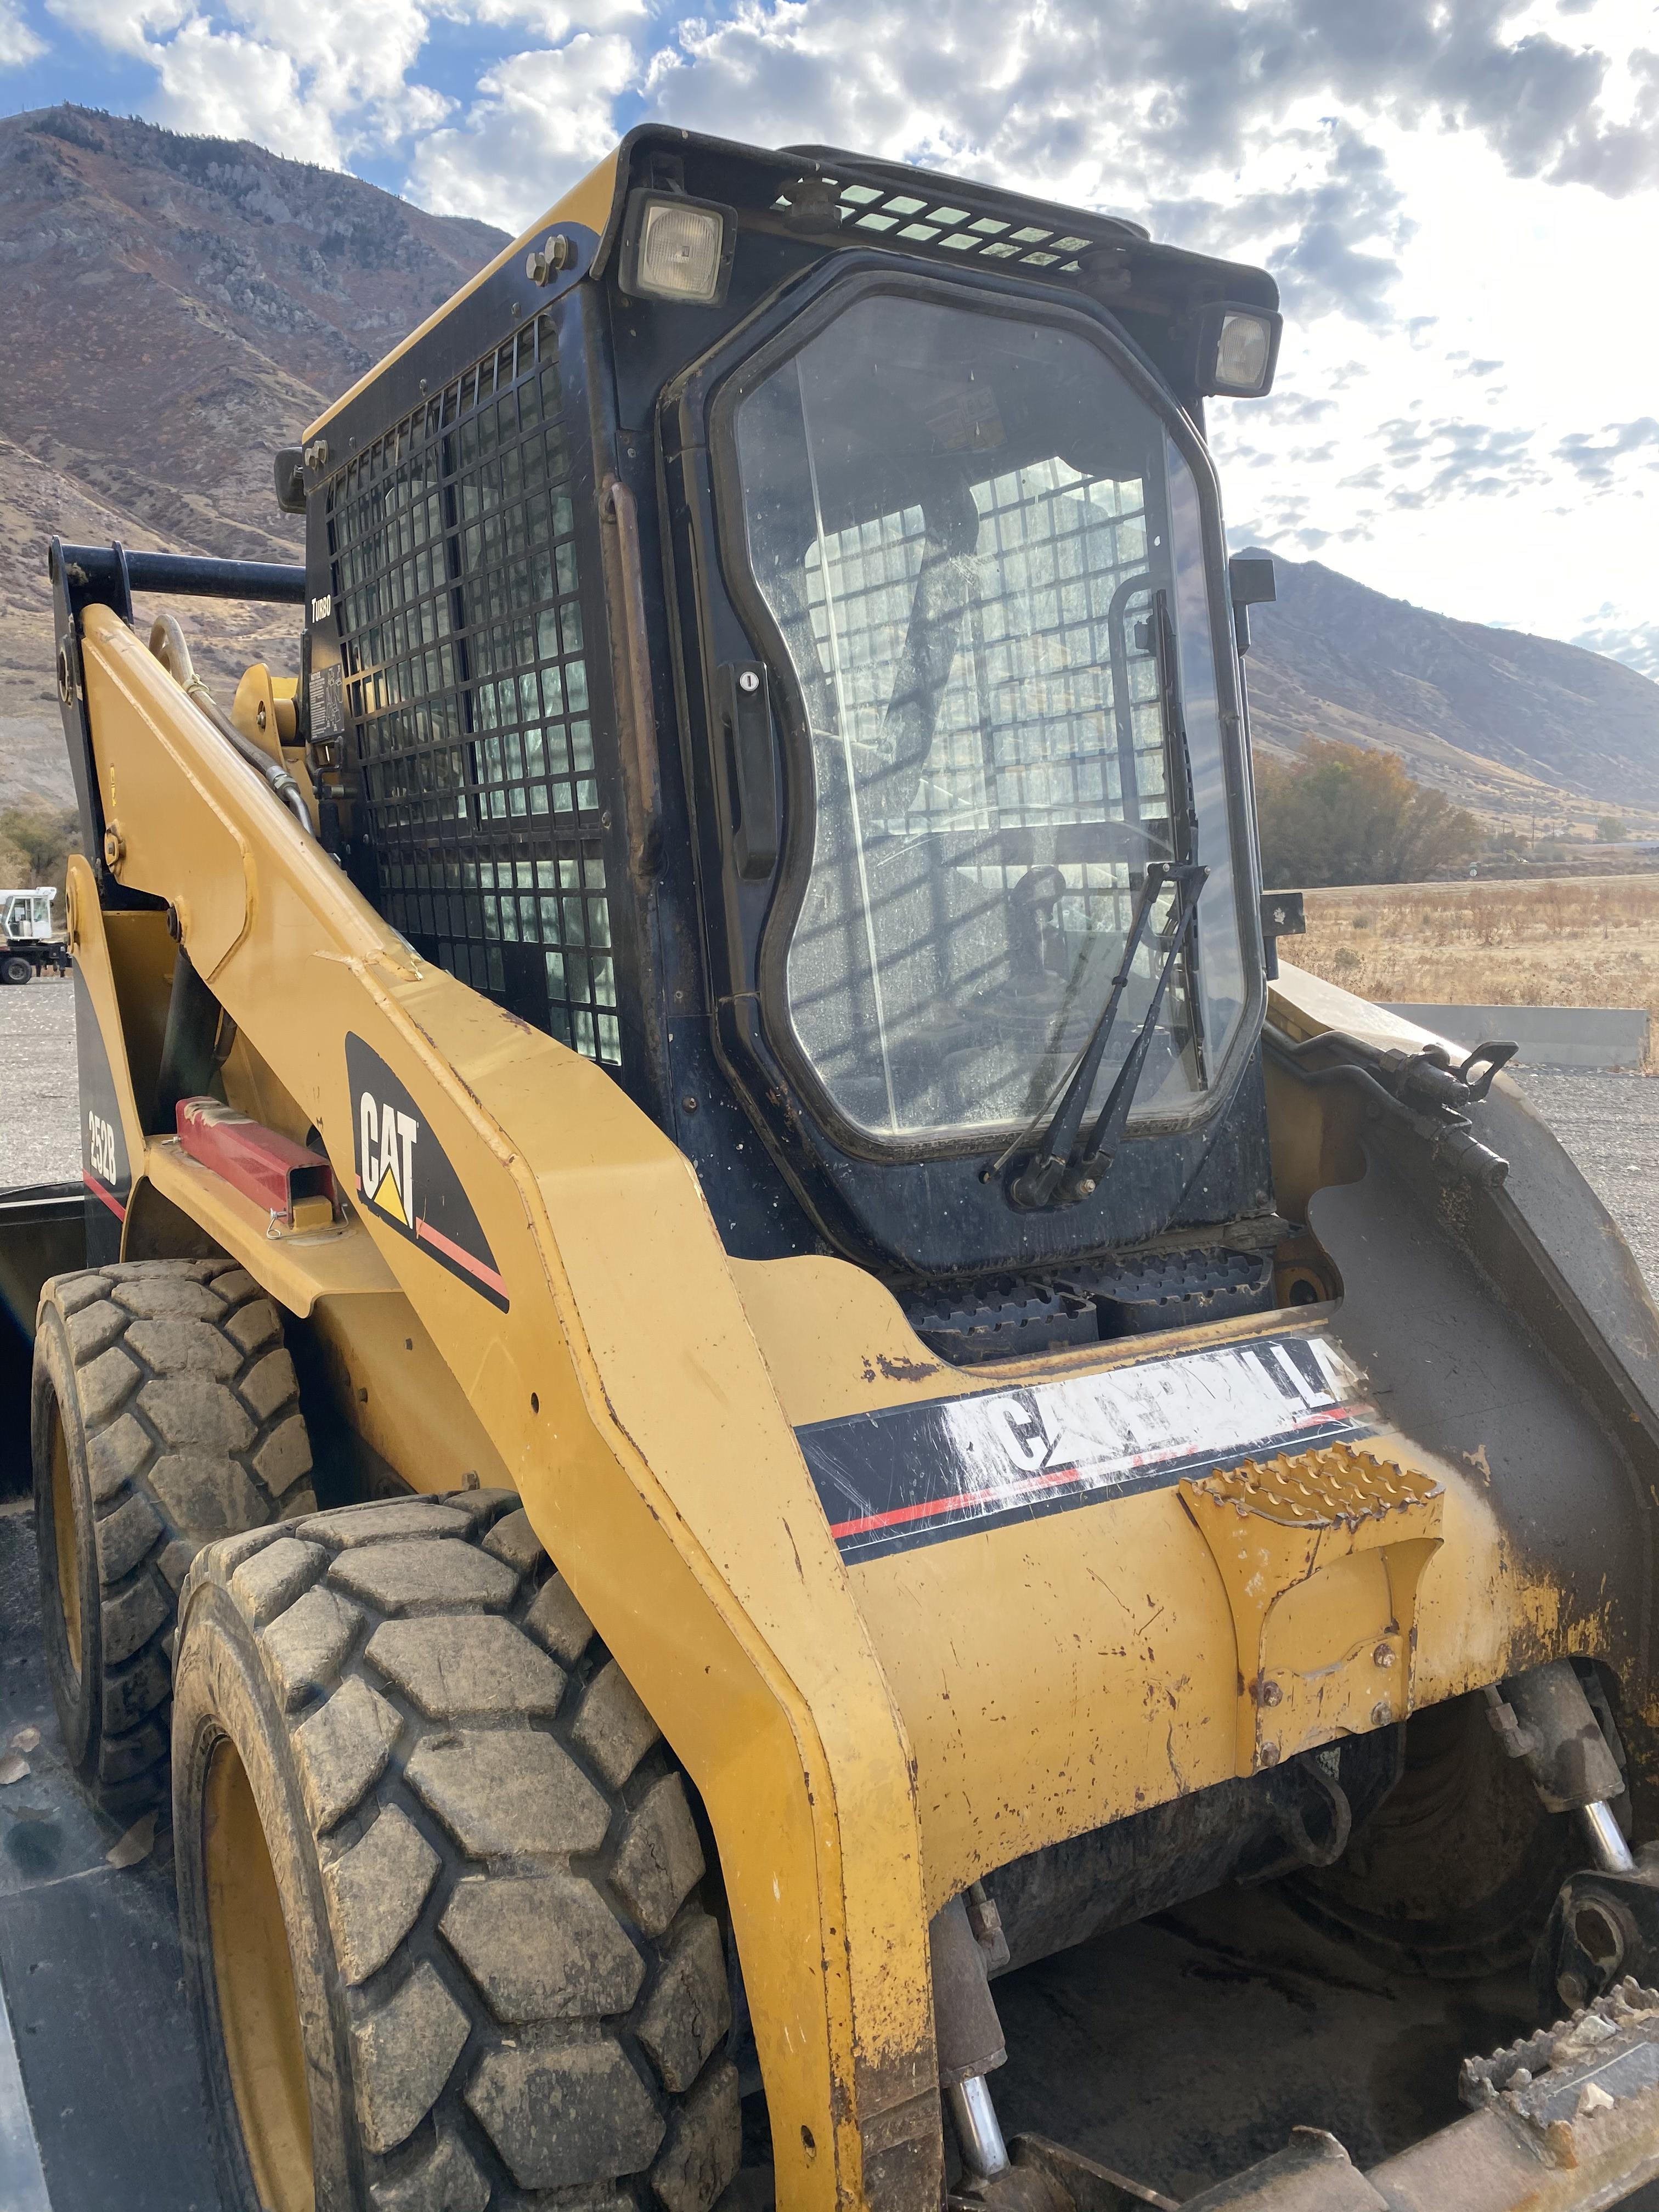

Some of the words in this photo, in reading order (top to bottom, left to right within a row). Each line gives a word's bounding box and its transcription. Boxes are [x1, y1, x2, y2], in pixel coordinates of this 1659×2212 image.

[312, 594, 331, 623] TURBO
[89, 1110, 116, 1186] 252B
[360, 1092, 417, 1229] CAT
